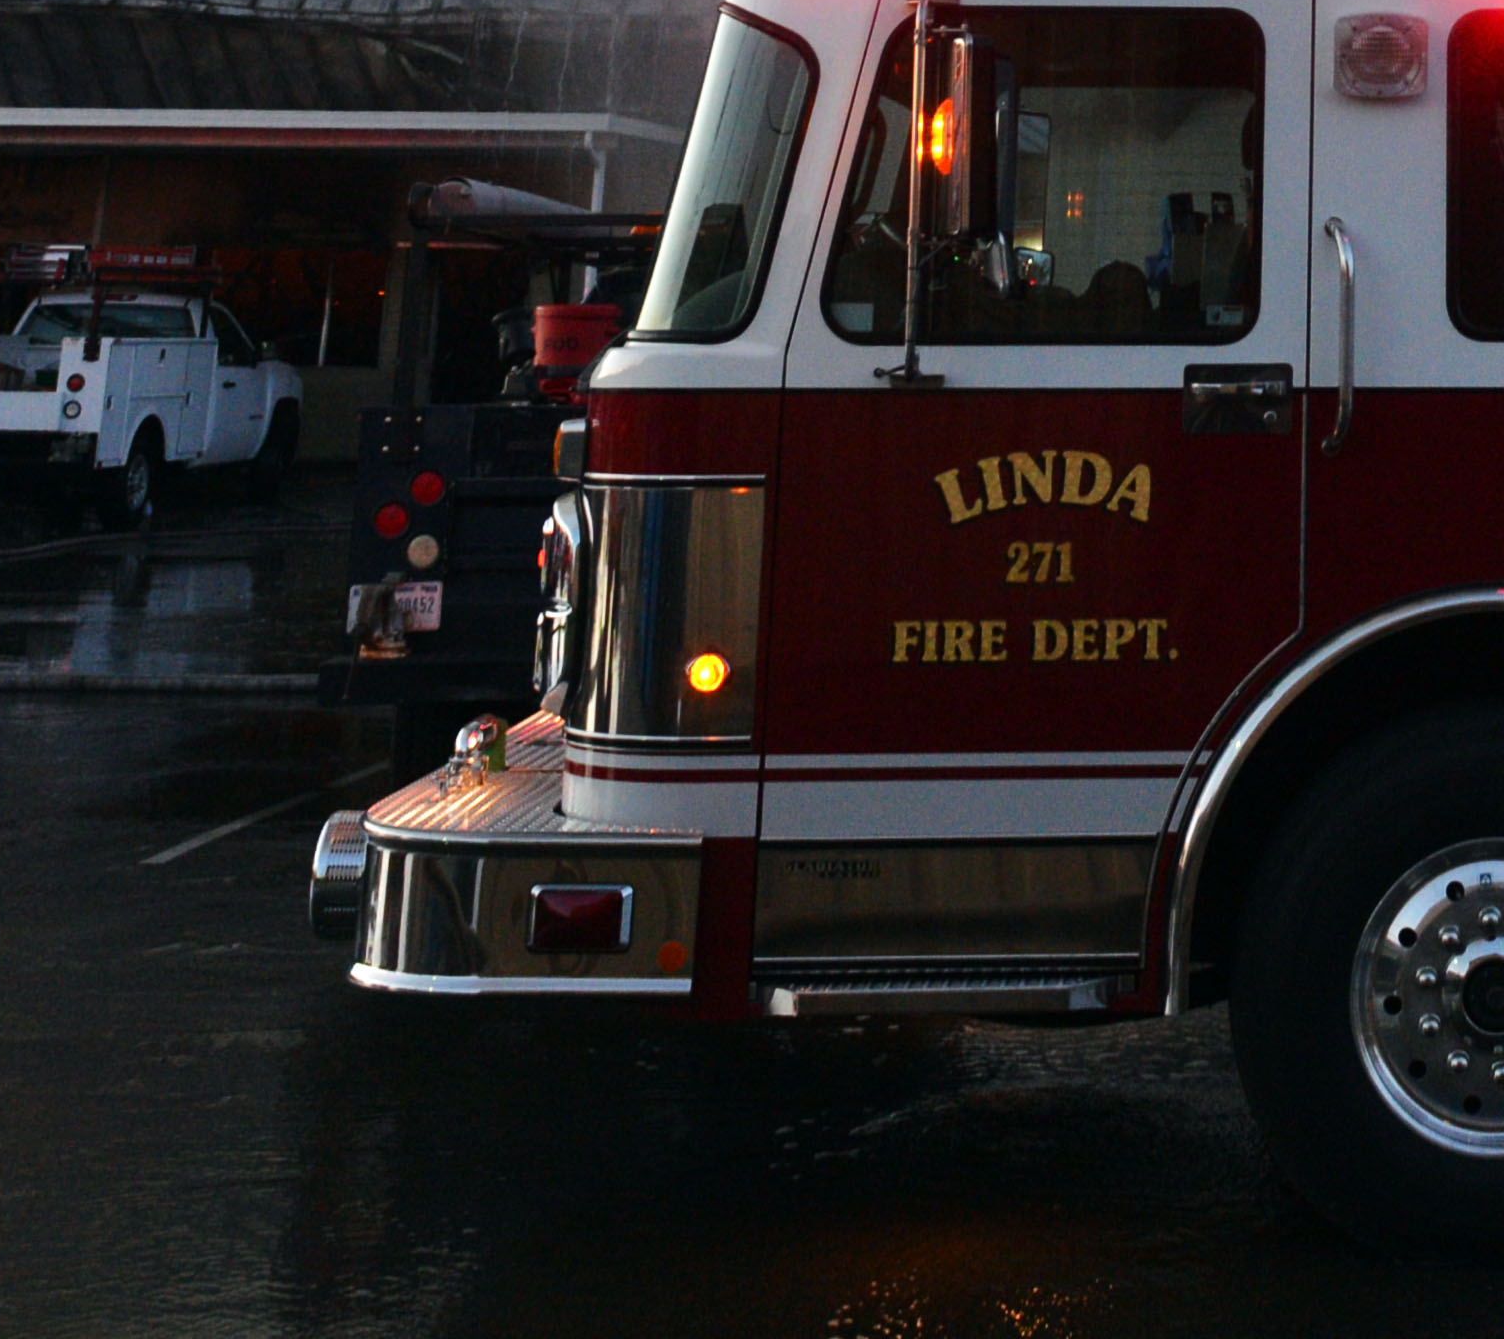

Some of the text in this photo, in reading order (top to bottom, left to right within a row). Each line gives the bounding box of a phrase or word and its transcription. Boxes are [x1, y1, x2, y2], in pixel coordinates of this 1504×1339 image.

[934, 450, 1151, 524] LINDA
[1005, 541, 1075, 583] 271
[892, 619, 1178, 662] FIRE DEPT.
